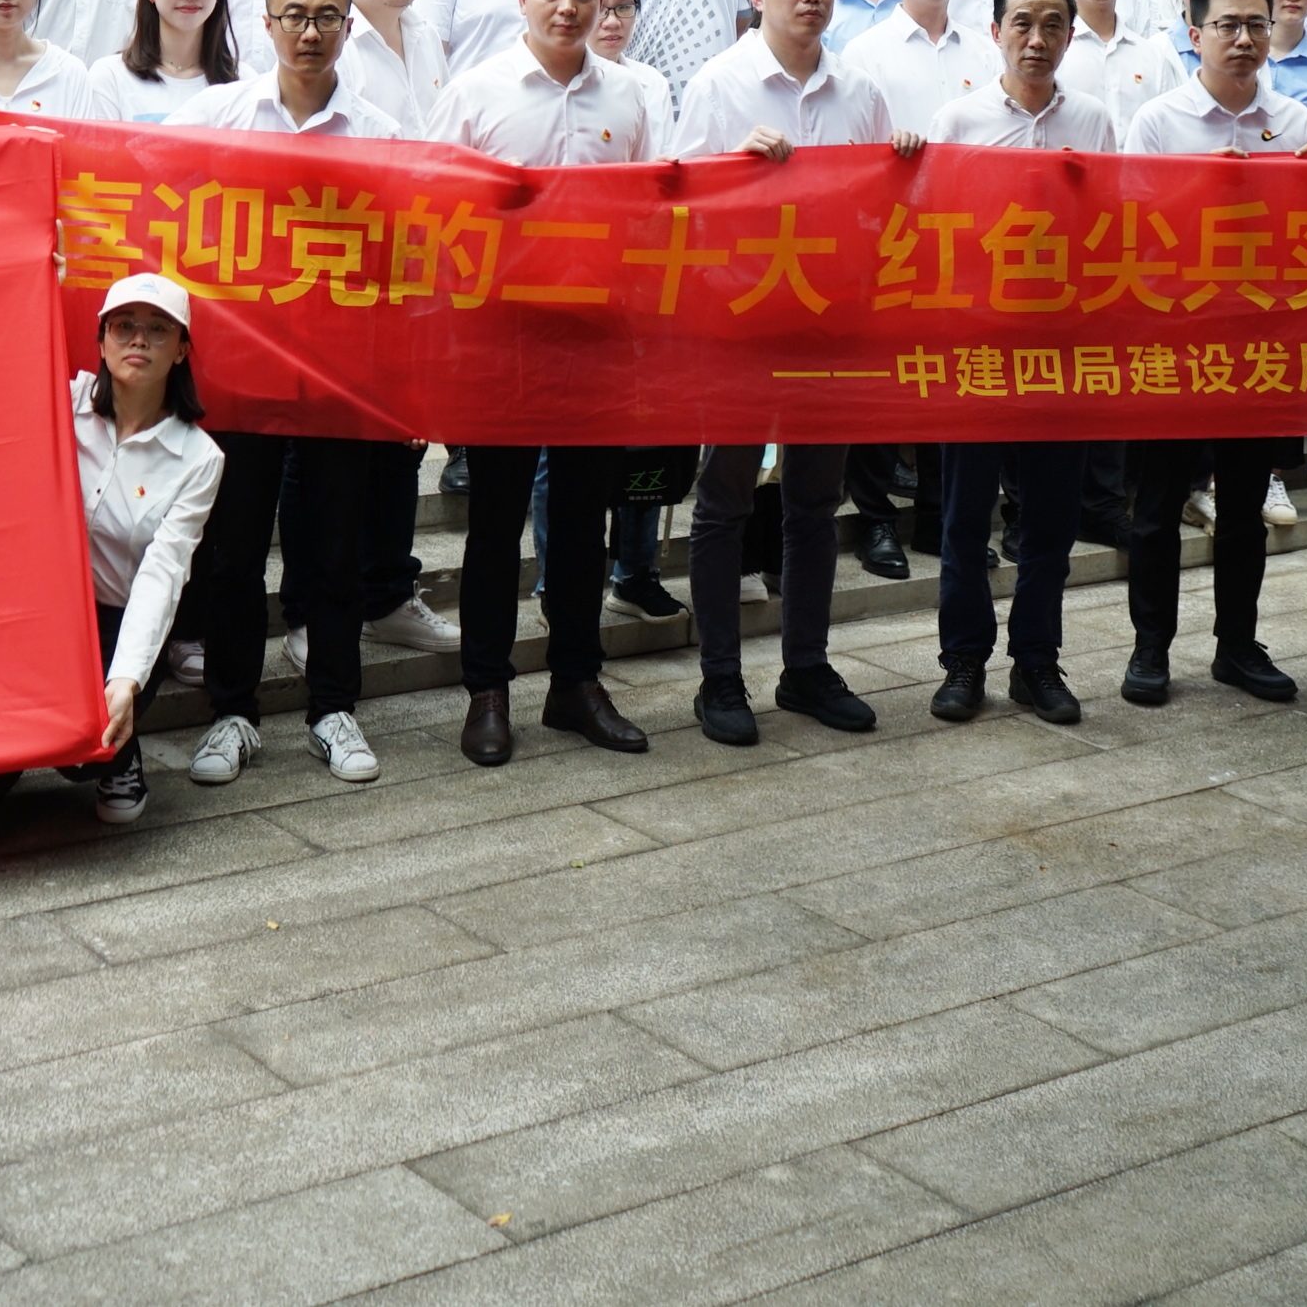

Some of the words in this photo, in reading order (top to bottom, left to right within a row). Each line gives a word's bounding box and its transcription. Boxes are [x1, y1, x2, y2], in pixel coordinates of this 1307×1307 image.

[58, 171, 836, 315] 喜迎党的二十大
